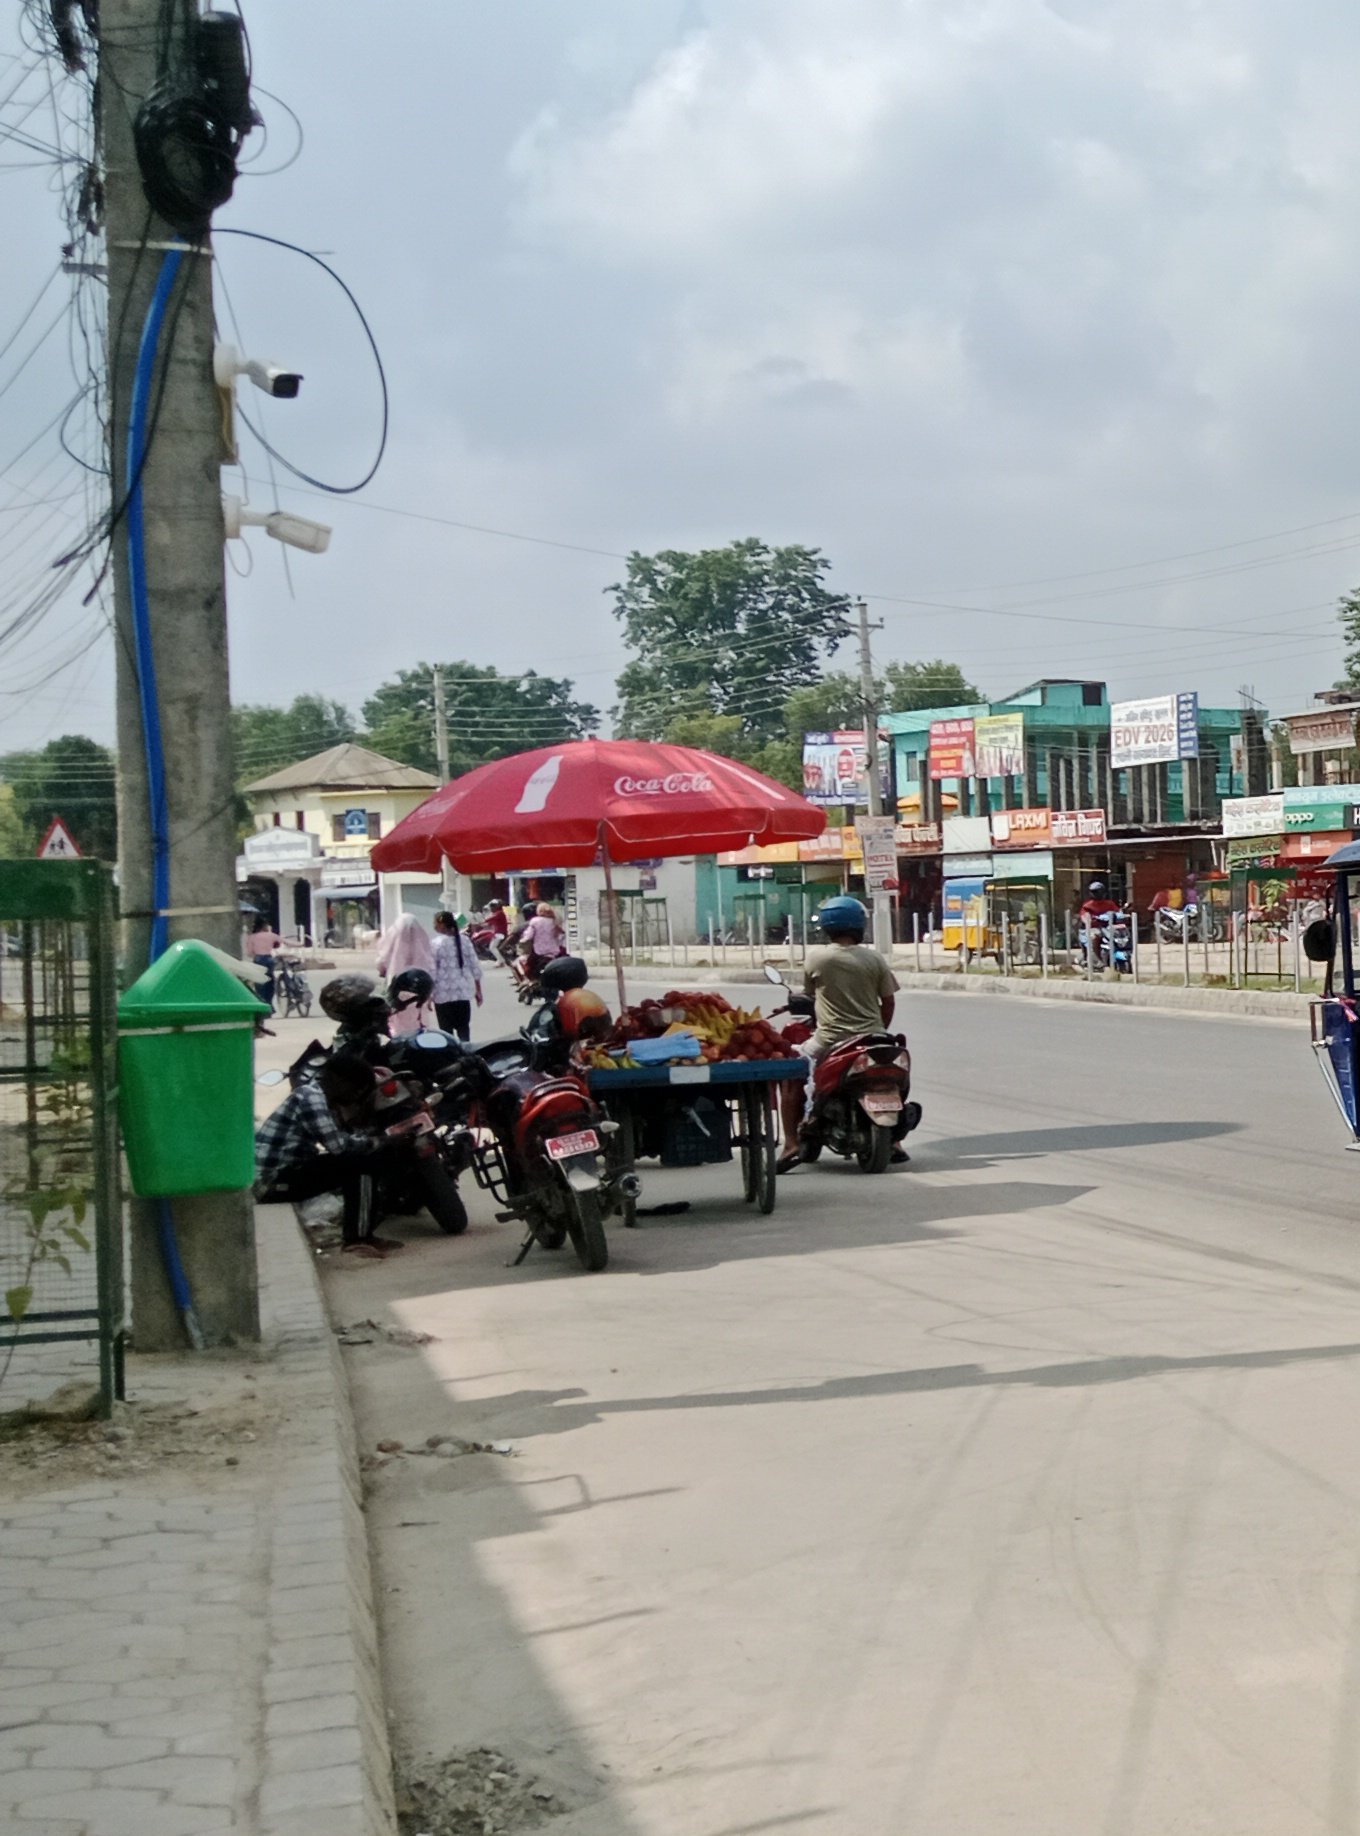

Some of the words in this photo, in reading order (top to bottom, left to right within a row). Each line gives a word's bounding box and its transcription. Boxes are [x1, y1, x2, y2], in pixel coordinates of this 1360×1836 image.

[1114, 727, 1141, 748] EDV
[1144, 722, 1175, 745] 2026
[613, 771, 714, 797] Coca-Cola
[1009, 812, 1047, 829] LAXMI
